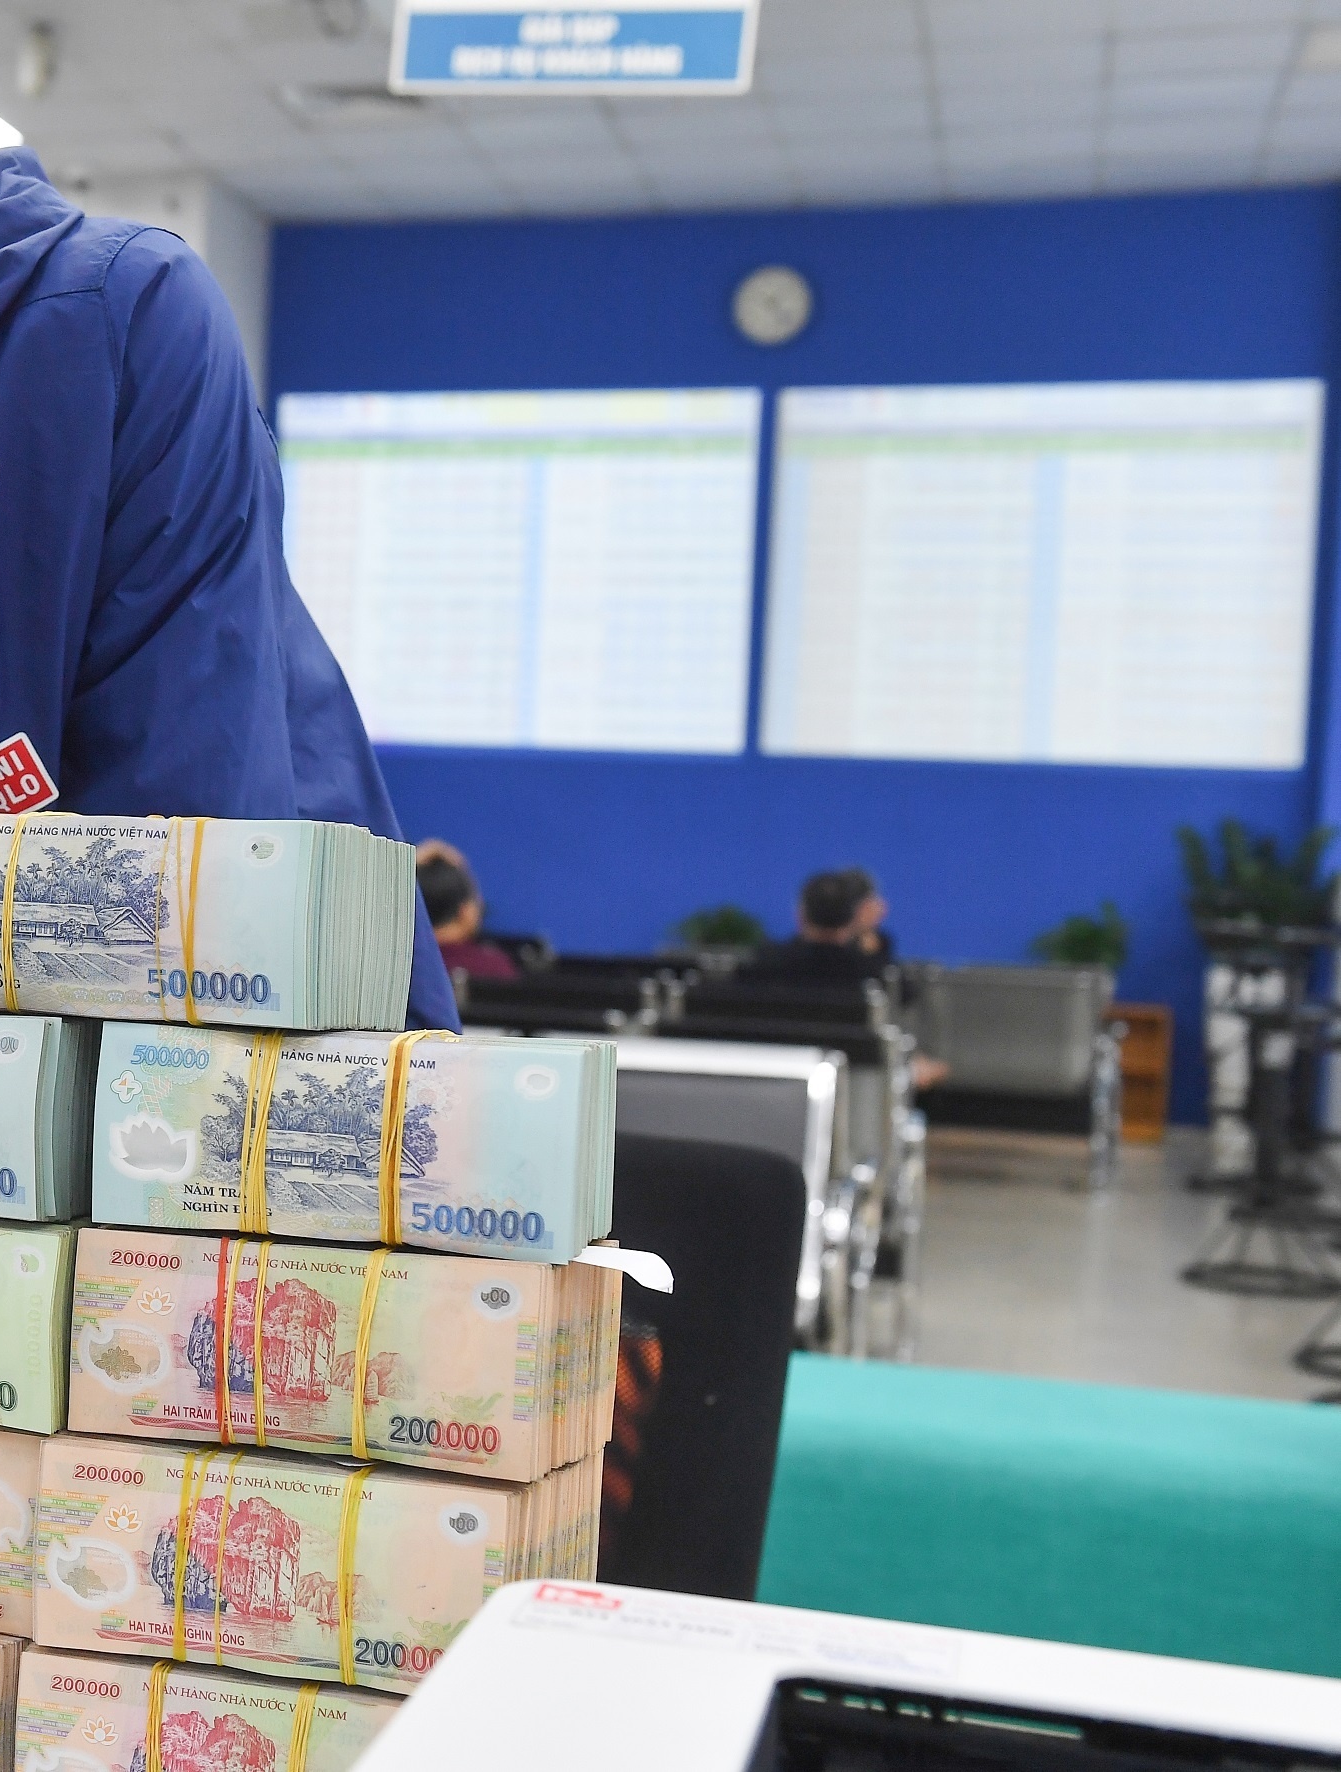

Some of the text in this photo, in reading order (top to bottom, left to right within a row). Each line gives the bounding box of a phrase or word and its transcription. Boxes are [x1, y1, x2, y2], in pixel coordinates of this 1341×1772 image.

[29, 826, 58, 836] HÀNG
[61, 825, 83, 836] NHÀ
[86, 825, 116, 837] NƯỚC
[119, 826, 142, 840] VIỆT
[280, 1050, 314, 1062] HÀNG
[317, 1052, 341, 1063] NHÀ
[345, 1055, 378, 1066] NƯỚC
[410, 1059, 436, 1069] NAM
[184, 1182, 215, 1196] NĂM
[183, 1201, 229, 1213] NGHÌN
[281, 1259, 307, 1270] NHÀ
[310, 1262, 347, 1274] NƯỚC
[380, 1270, 408, 1280] NAM
[163, 1405, 180, 1416] HAI
[183, 1406, 211, 1420] TRĂM
[245, 1476, 271, 1489] NHÀ
[274, 1480, 311, 1493] NƯỚC
[313, 1485, 341, 1497] VIỆT
[129, 1620, 146, 1632] HAI
[180, 1686, 216, 1701] HÀNG
[219, 1692, 246, 1706] NHÀ
[249, 1697, 286, 1712] NƯỚC
[317, 1708, 347, 1720] NAM
